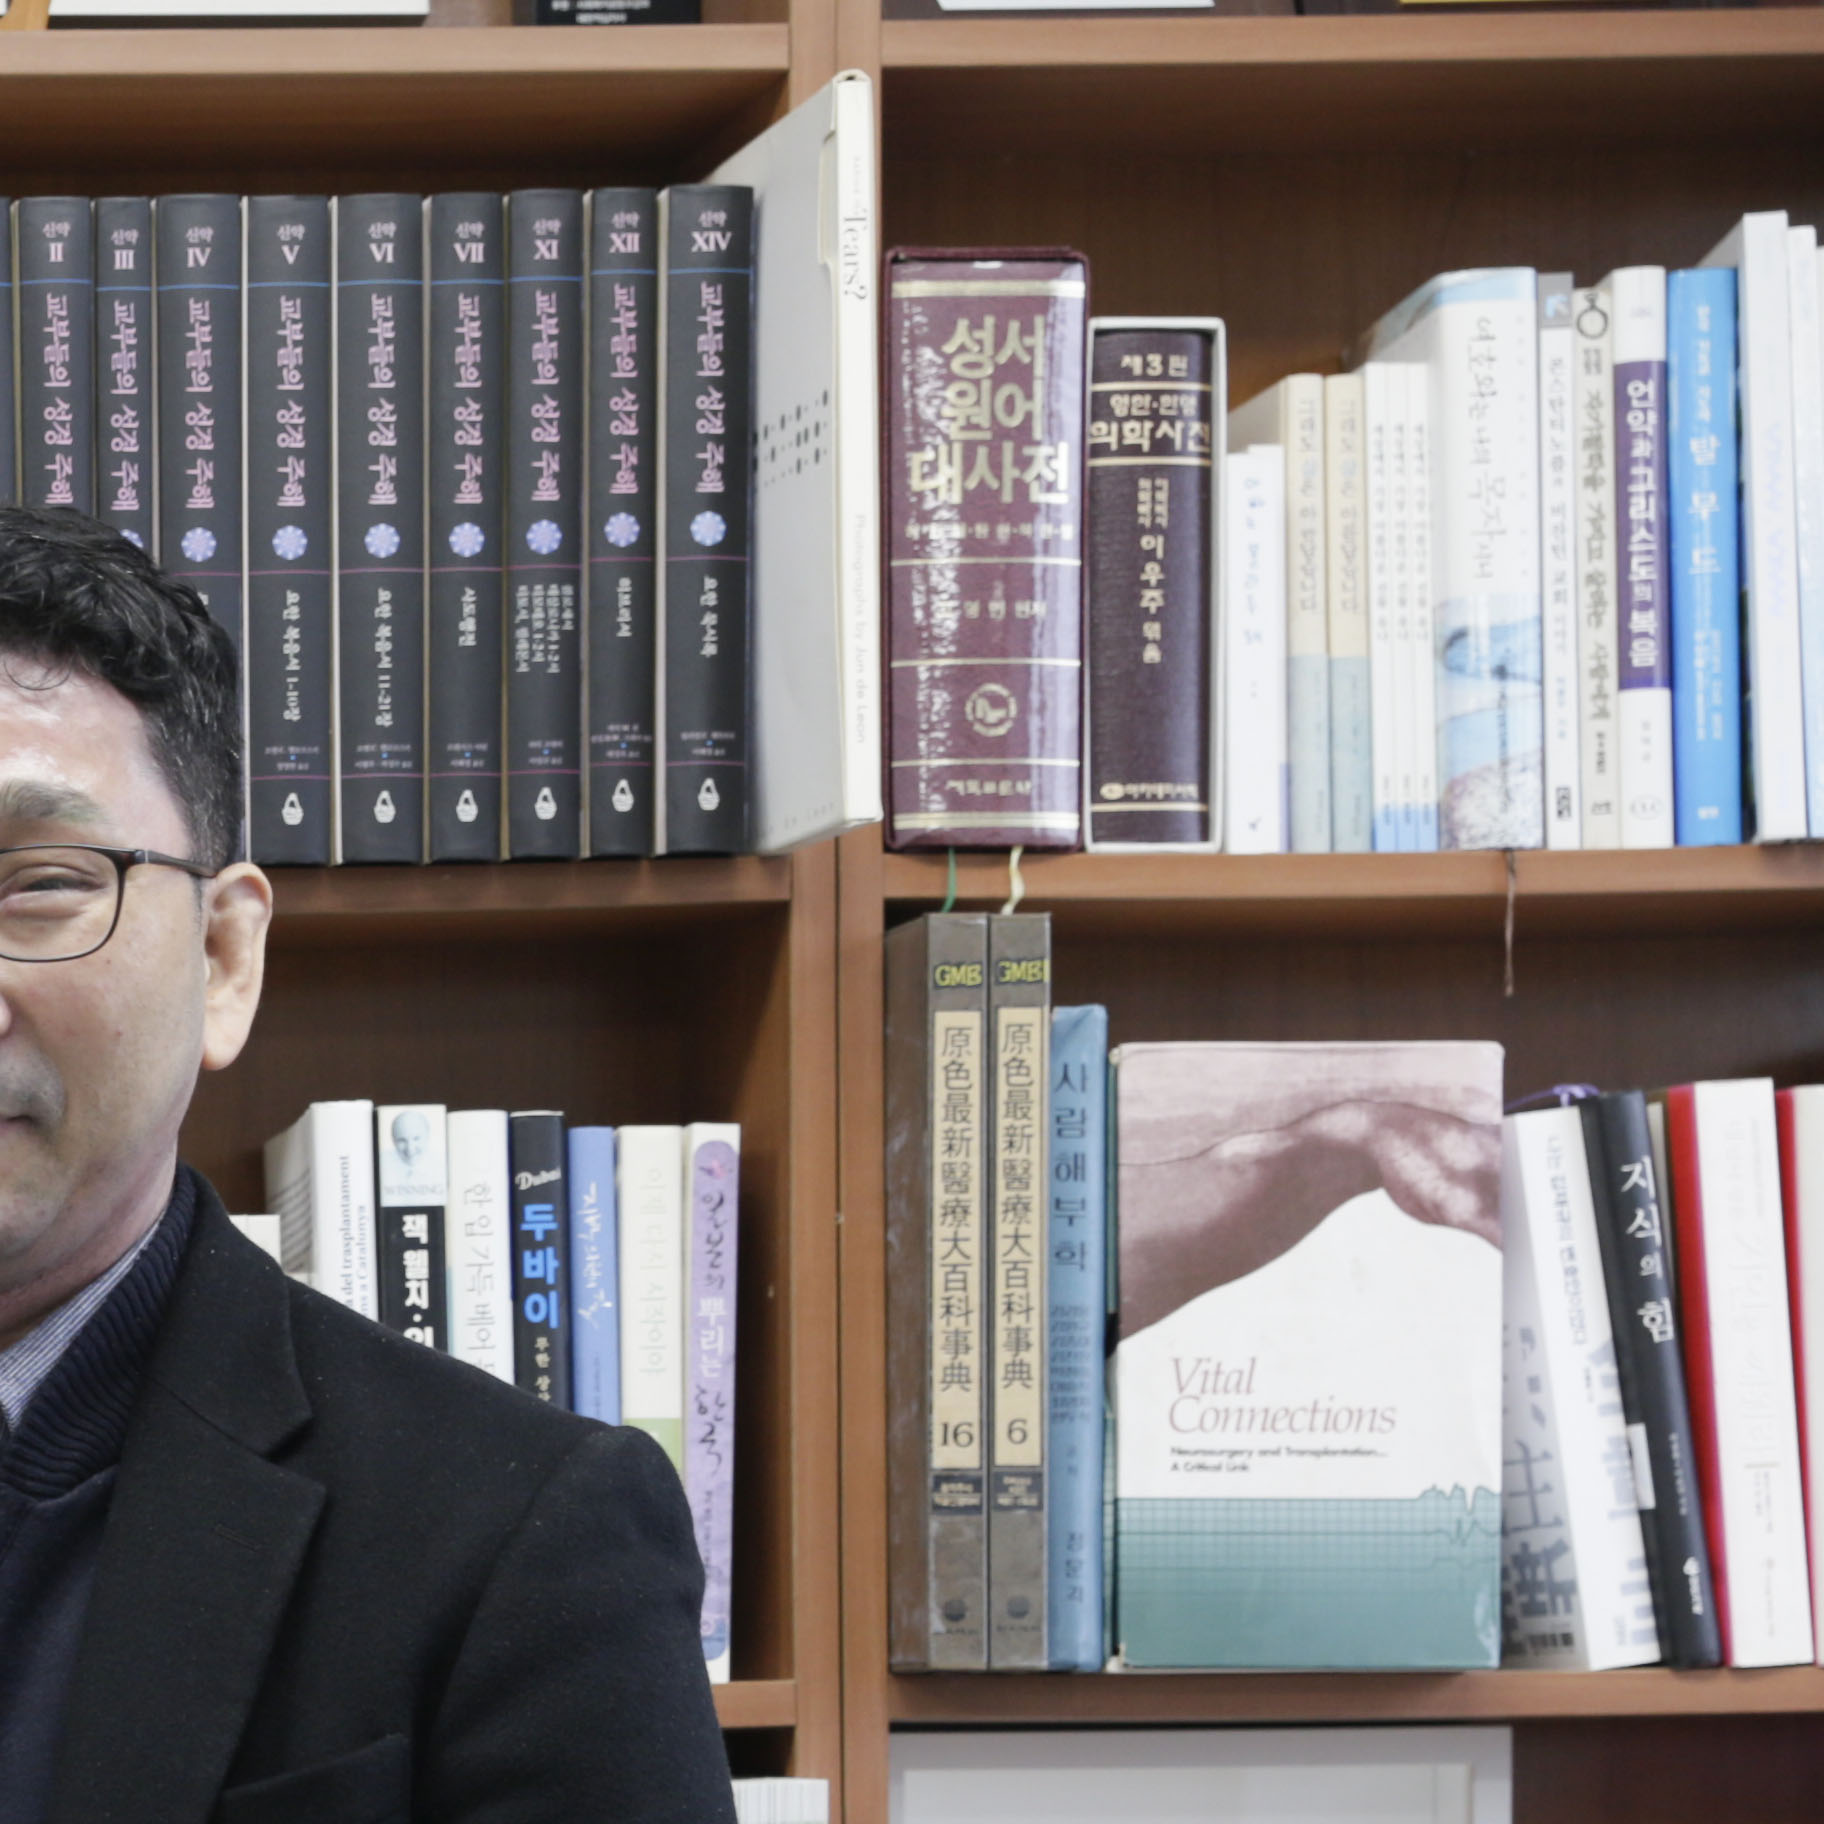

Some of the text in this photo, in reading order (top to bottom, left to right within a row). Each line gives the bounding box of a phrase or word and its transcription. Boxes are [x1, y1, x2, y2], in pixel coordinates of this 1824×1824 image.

[691, 232, 732, 252] XIV
[698, 211, 728, 228] 신약
[942, 314, 1044, 379] 성서
[695, 282, 725, 493] 교부들의 성경 주해
[947, 379, 1042, 442] 원어
[1091, 419, 1210, 453] 의학사전
[910, 440, 1070, 505] 대사전
[935, 965, 981, 985] GMB
[1053, 1061, 1090, 1271] 사람해부학
[941, 1026, 974, 1392] 原色最新醫療大百科事典
[1002, 1023, 1034, 1389] 原色最新醫療大百科事典
[519, 1204, 560, 1329] 두바이
[1172, 1356, 1257, 1395] Vital
[941, 1420, 974, 1448] 16
[1007, 1418, 1028, 1445] 6
[1169, 1395, 1397, 1434] Connections
